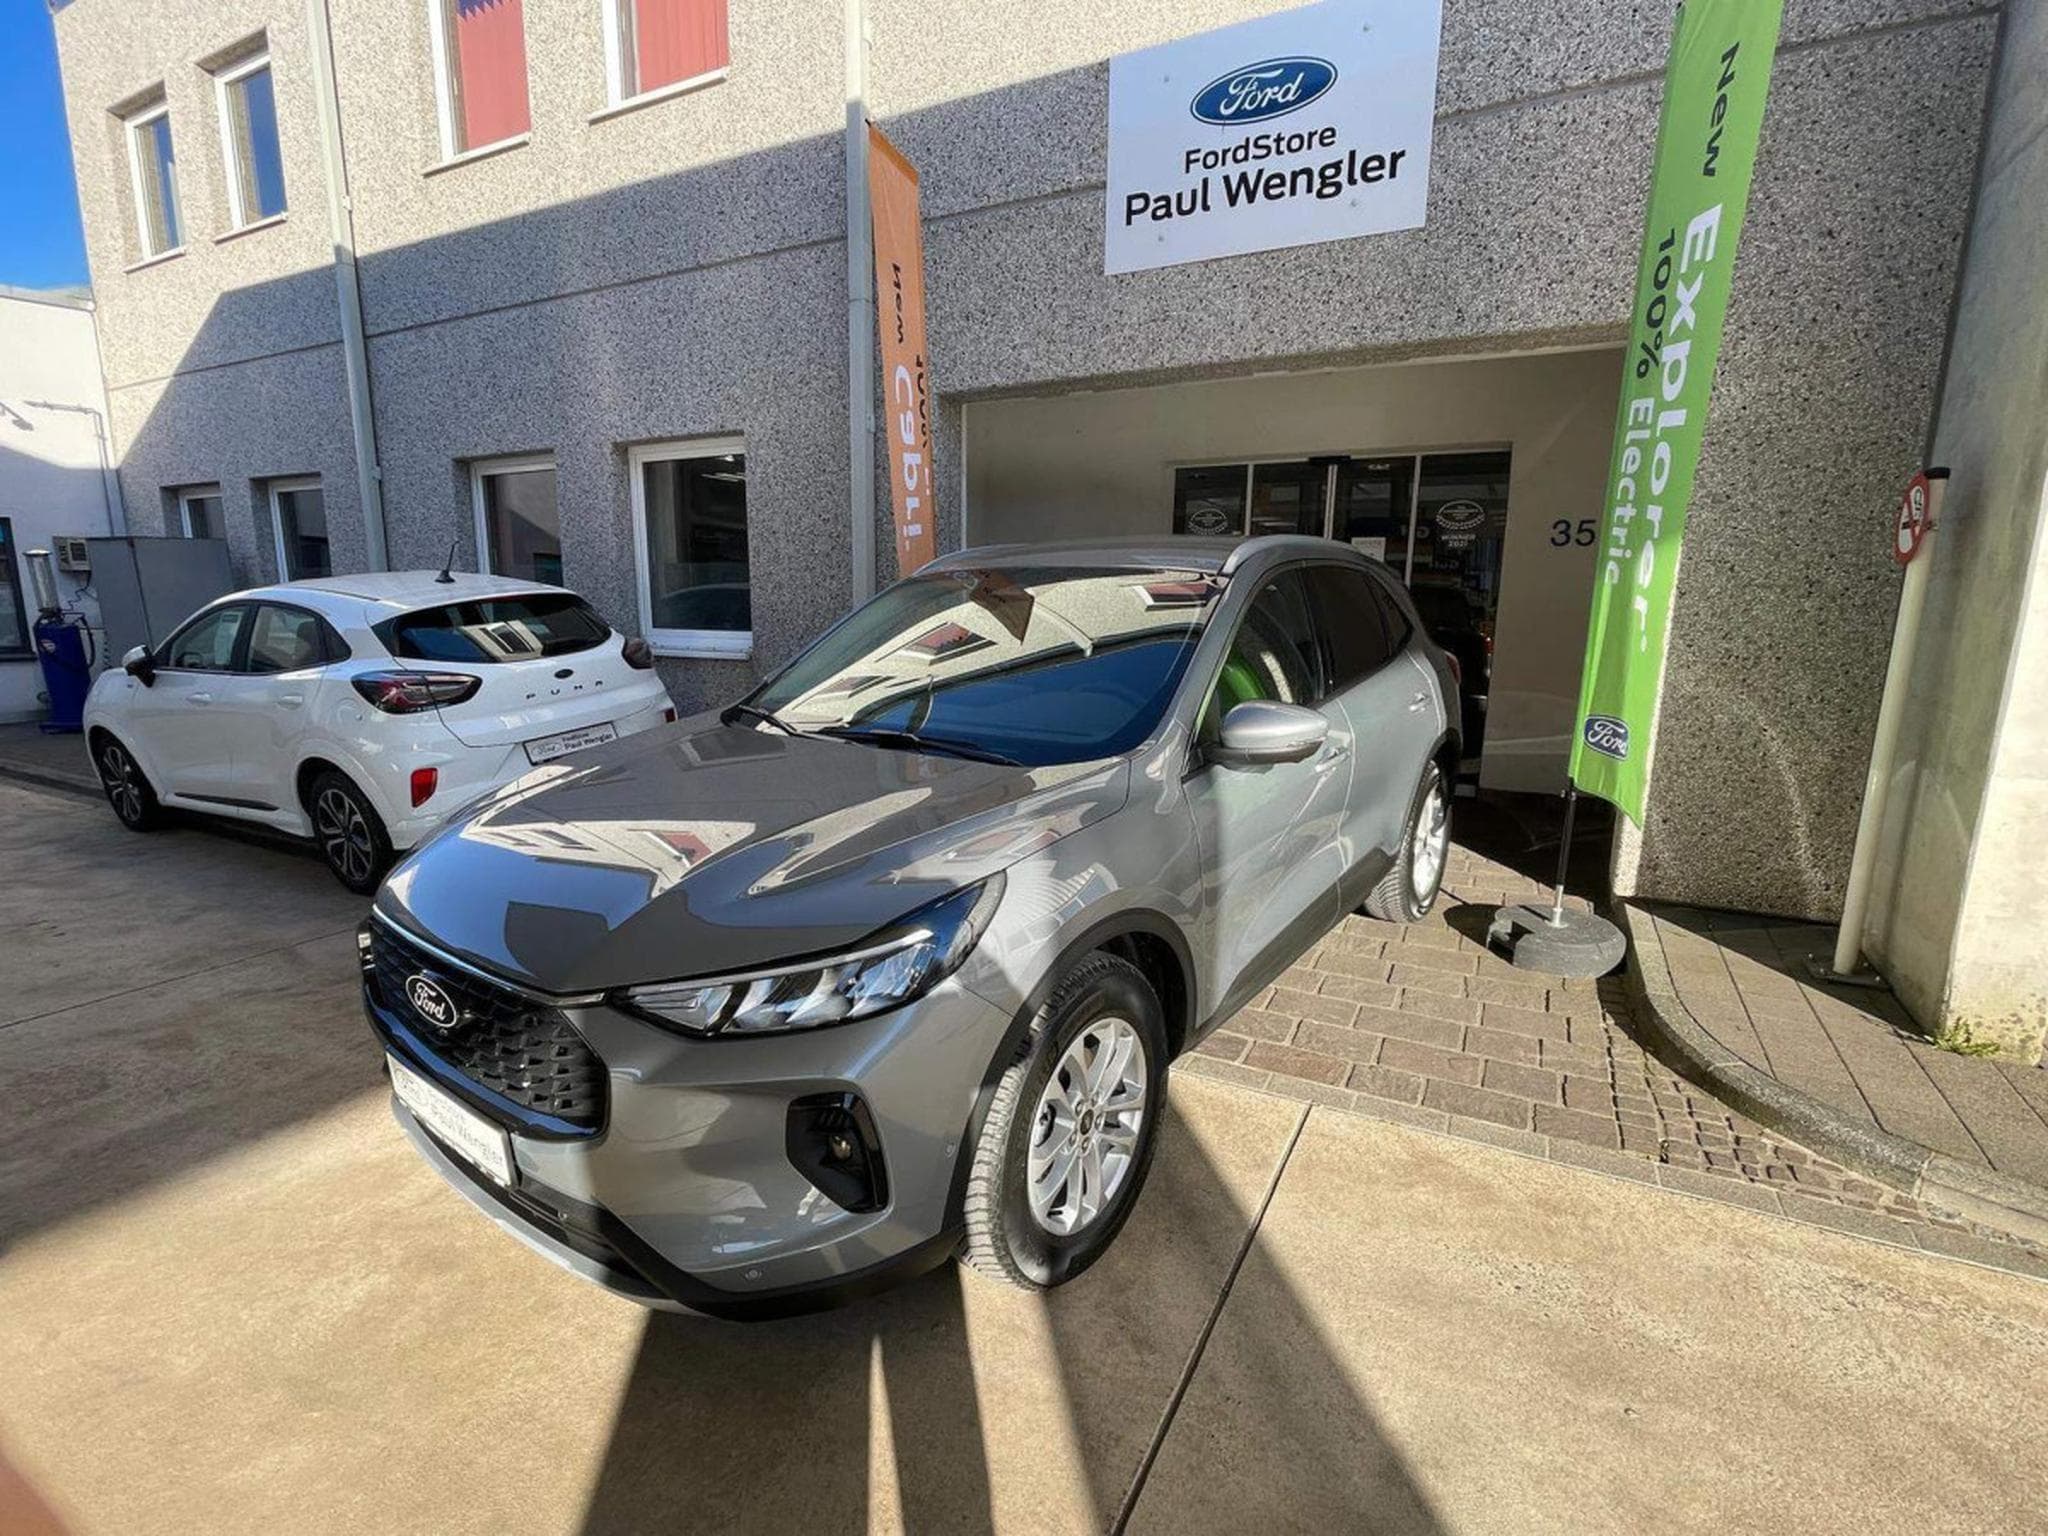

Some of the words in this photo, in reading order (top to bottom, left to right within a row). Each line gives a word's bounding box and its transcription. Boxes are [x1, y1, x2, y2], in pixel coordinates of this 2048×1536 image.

[1219, 68, 1304, 116] Ford
[1702, 41, 1741, 177] New
[1124, 178, 1211, 226] Paul
[1222, 149, 1407, 208] Wengler
[1185, 126, 1337, 174] FordStore
[1636, 228, 1676, 379] 100%
[1633, 203, 1723, 634] Explorer
[1604, 397, 1655, 585] Electric
[1551, 519, 1596, 547] 35
[413, 980, 446, 1022] Ford
